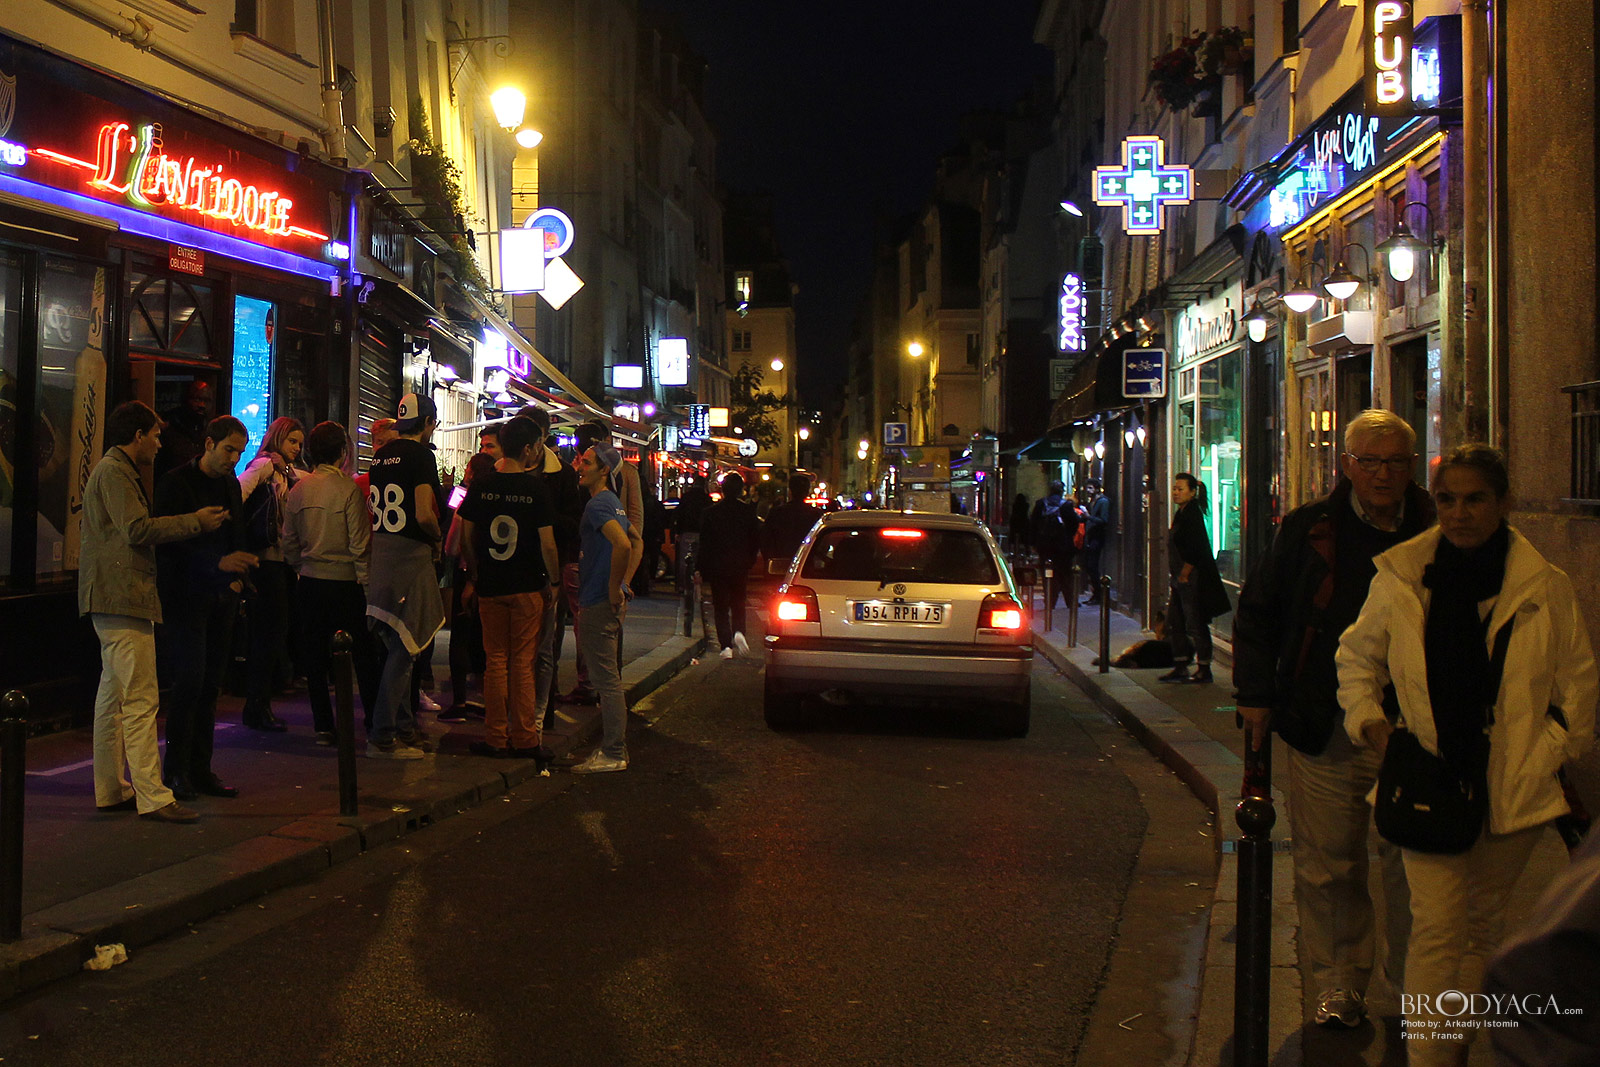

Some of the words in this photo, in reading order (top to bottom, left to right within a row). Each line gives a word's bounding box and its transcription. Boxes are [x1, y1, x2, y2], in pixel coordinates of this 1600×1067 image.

[1374, 2, 1404, 104] PUB
[170, 257, 204, 274] OBLIGATOIRE
[891, 427, 901, 441] P
[371, 458, 381, 466] OP
[383, 456, 401, 466] NORD
[481, 492, 501, 500] KOP
[505, 494, 533, 504] NORD
[488, 514, 519, 561] 9
[863, 606, 888, 619] 954
[894, 606, 918, 620] RPH
[924, 607, 940, 621] 75
